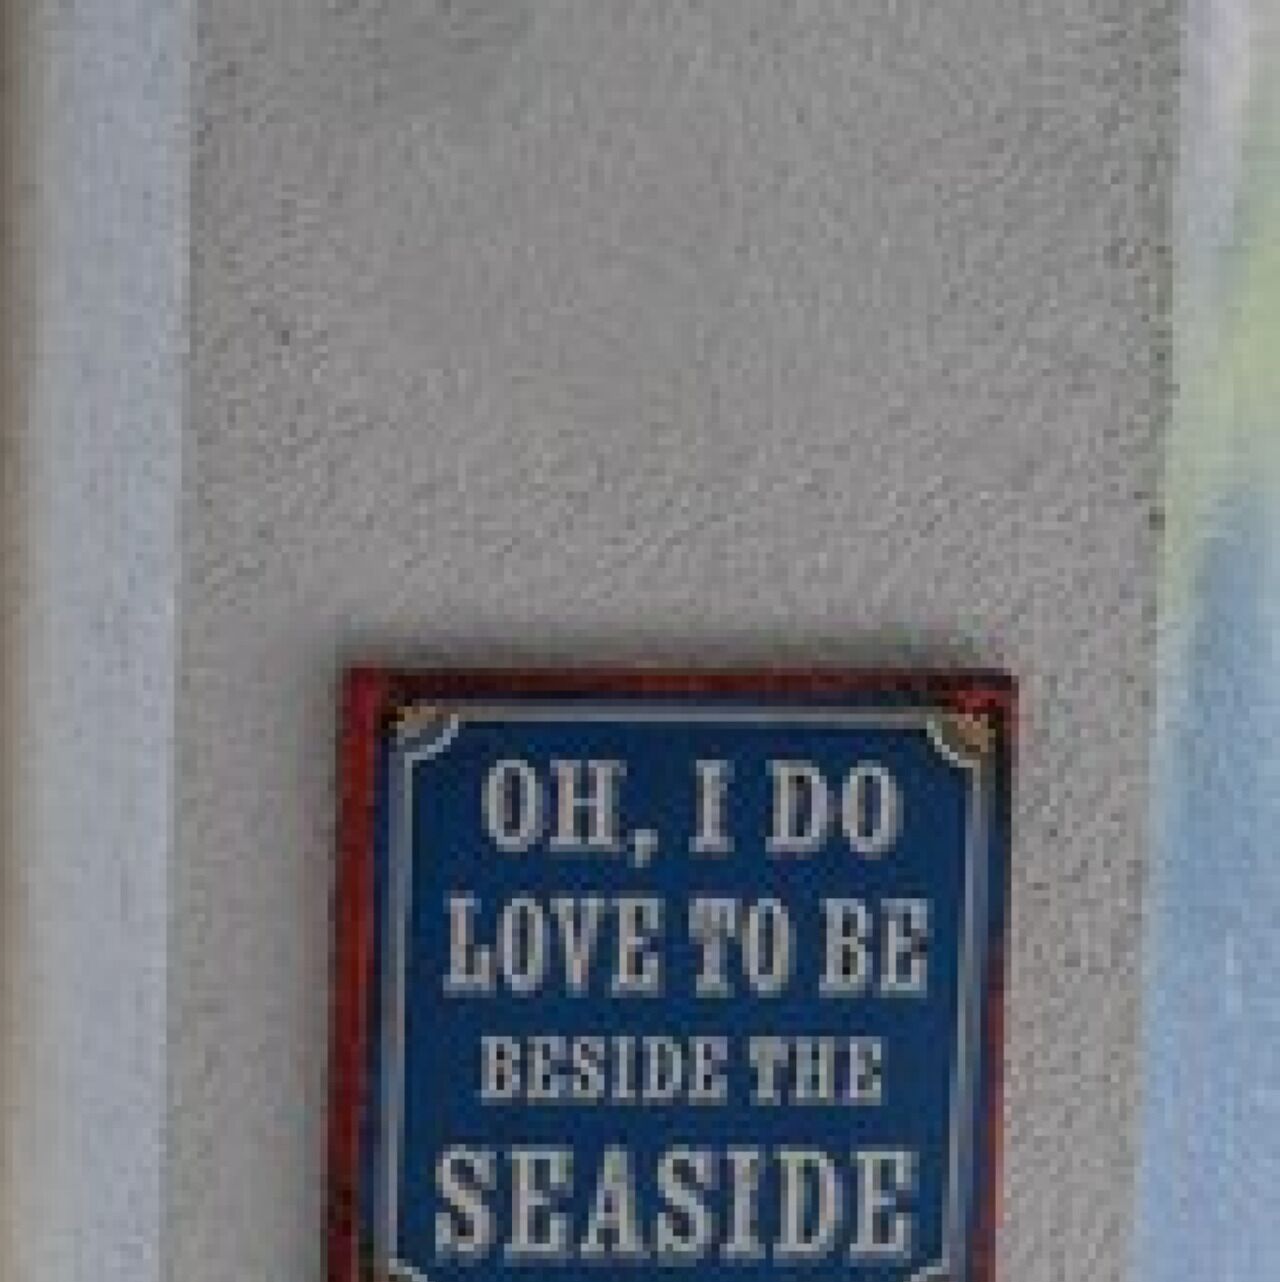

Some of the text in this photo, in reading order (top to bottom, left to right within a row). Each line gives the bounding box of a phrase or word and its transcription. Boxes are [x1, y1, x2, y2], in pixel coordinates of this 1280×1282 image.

[481, 759, 903, 867] OH, I DO
[441, 892, 934, 997] LOVE TO BE
[480, 1036, 883, 1106] BESIDE THE
[435, 1144, 919, 1264] SEASIDE
